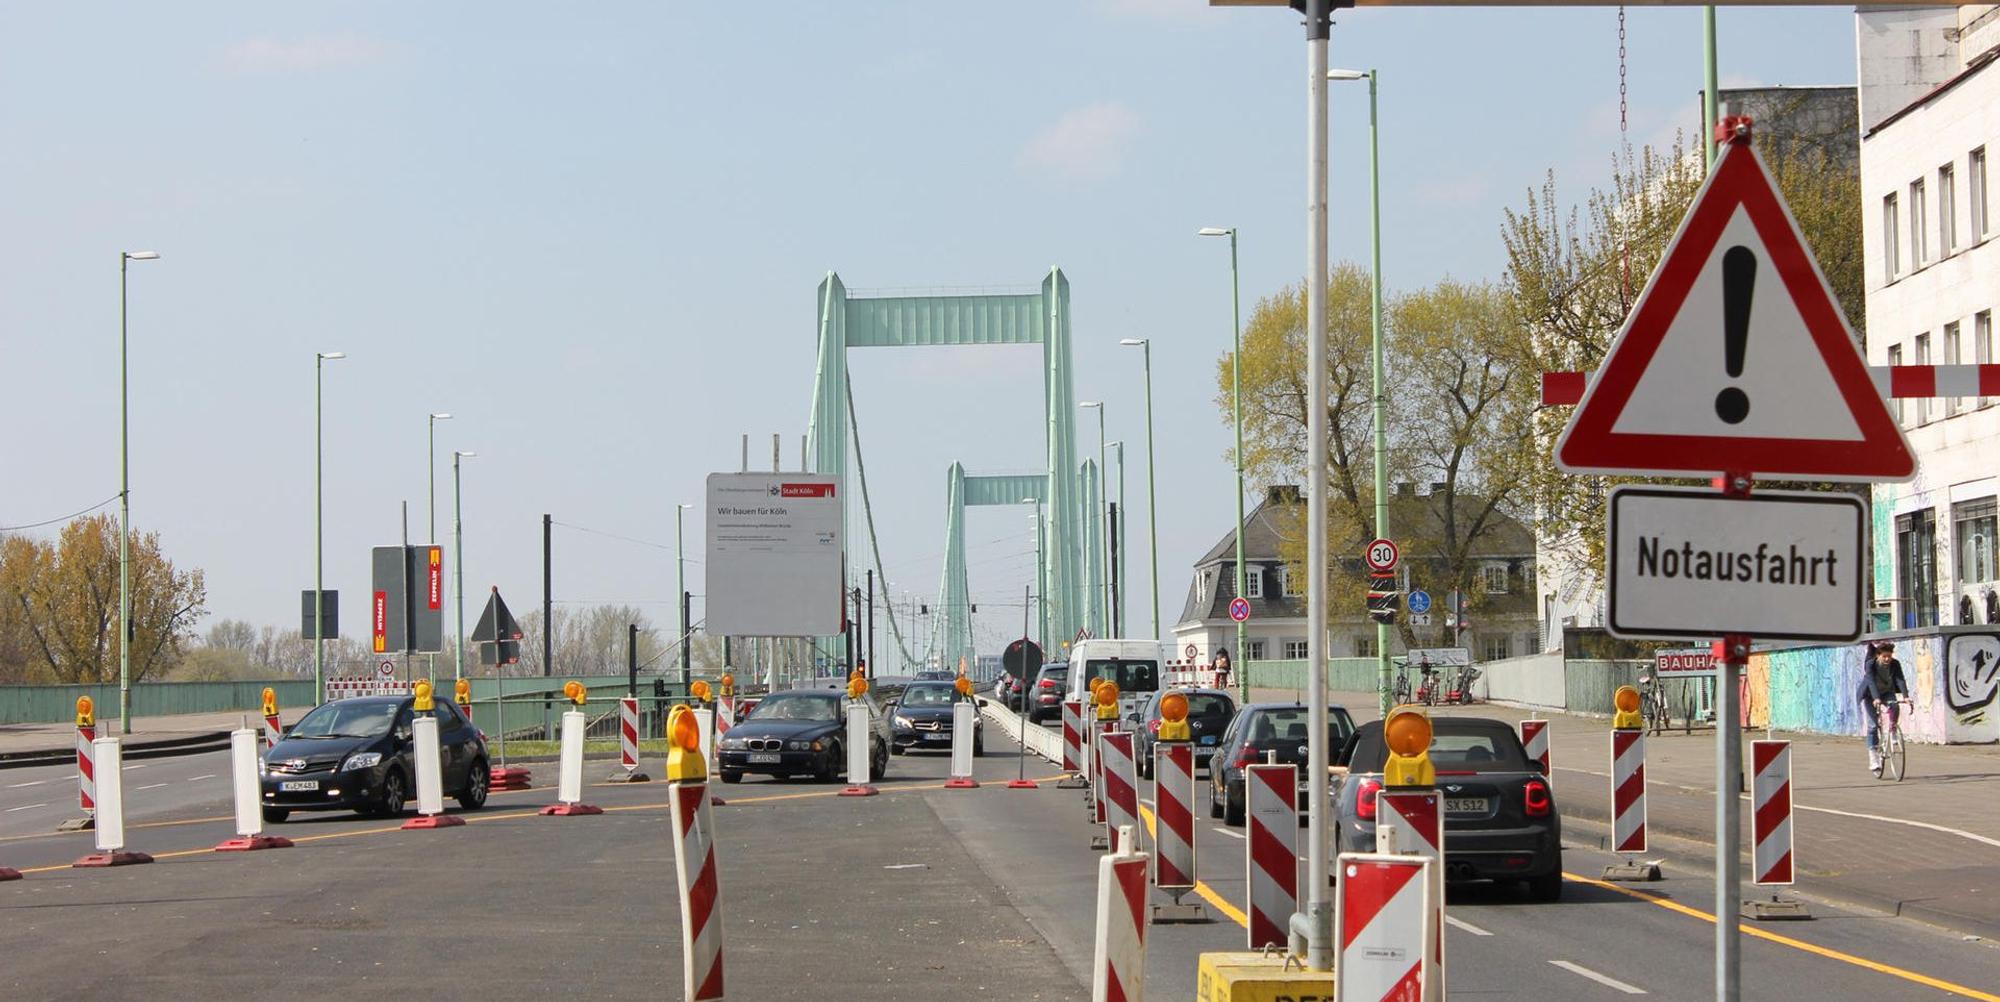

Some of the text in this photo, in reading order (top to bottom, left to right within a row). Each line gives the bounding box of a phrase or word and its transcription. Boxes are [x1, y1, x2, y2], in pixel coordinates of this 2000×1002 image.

[782, 487, 814, 495] Stadt Köln
[717, 507, 788, 516] Wir bauen für Köln
[1373, 547, 1392, 562] 30
[1637, 536, 1838, 587] Notausfahrt
[1660, 656, 1717, 669] BAUHA
[1446, 800, 1484, 811] SX 512
